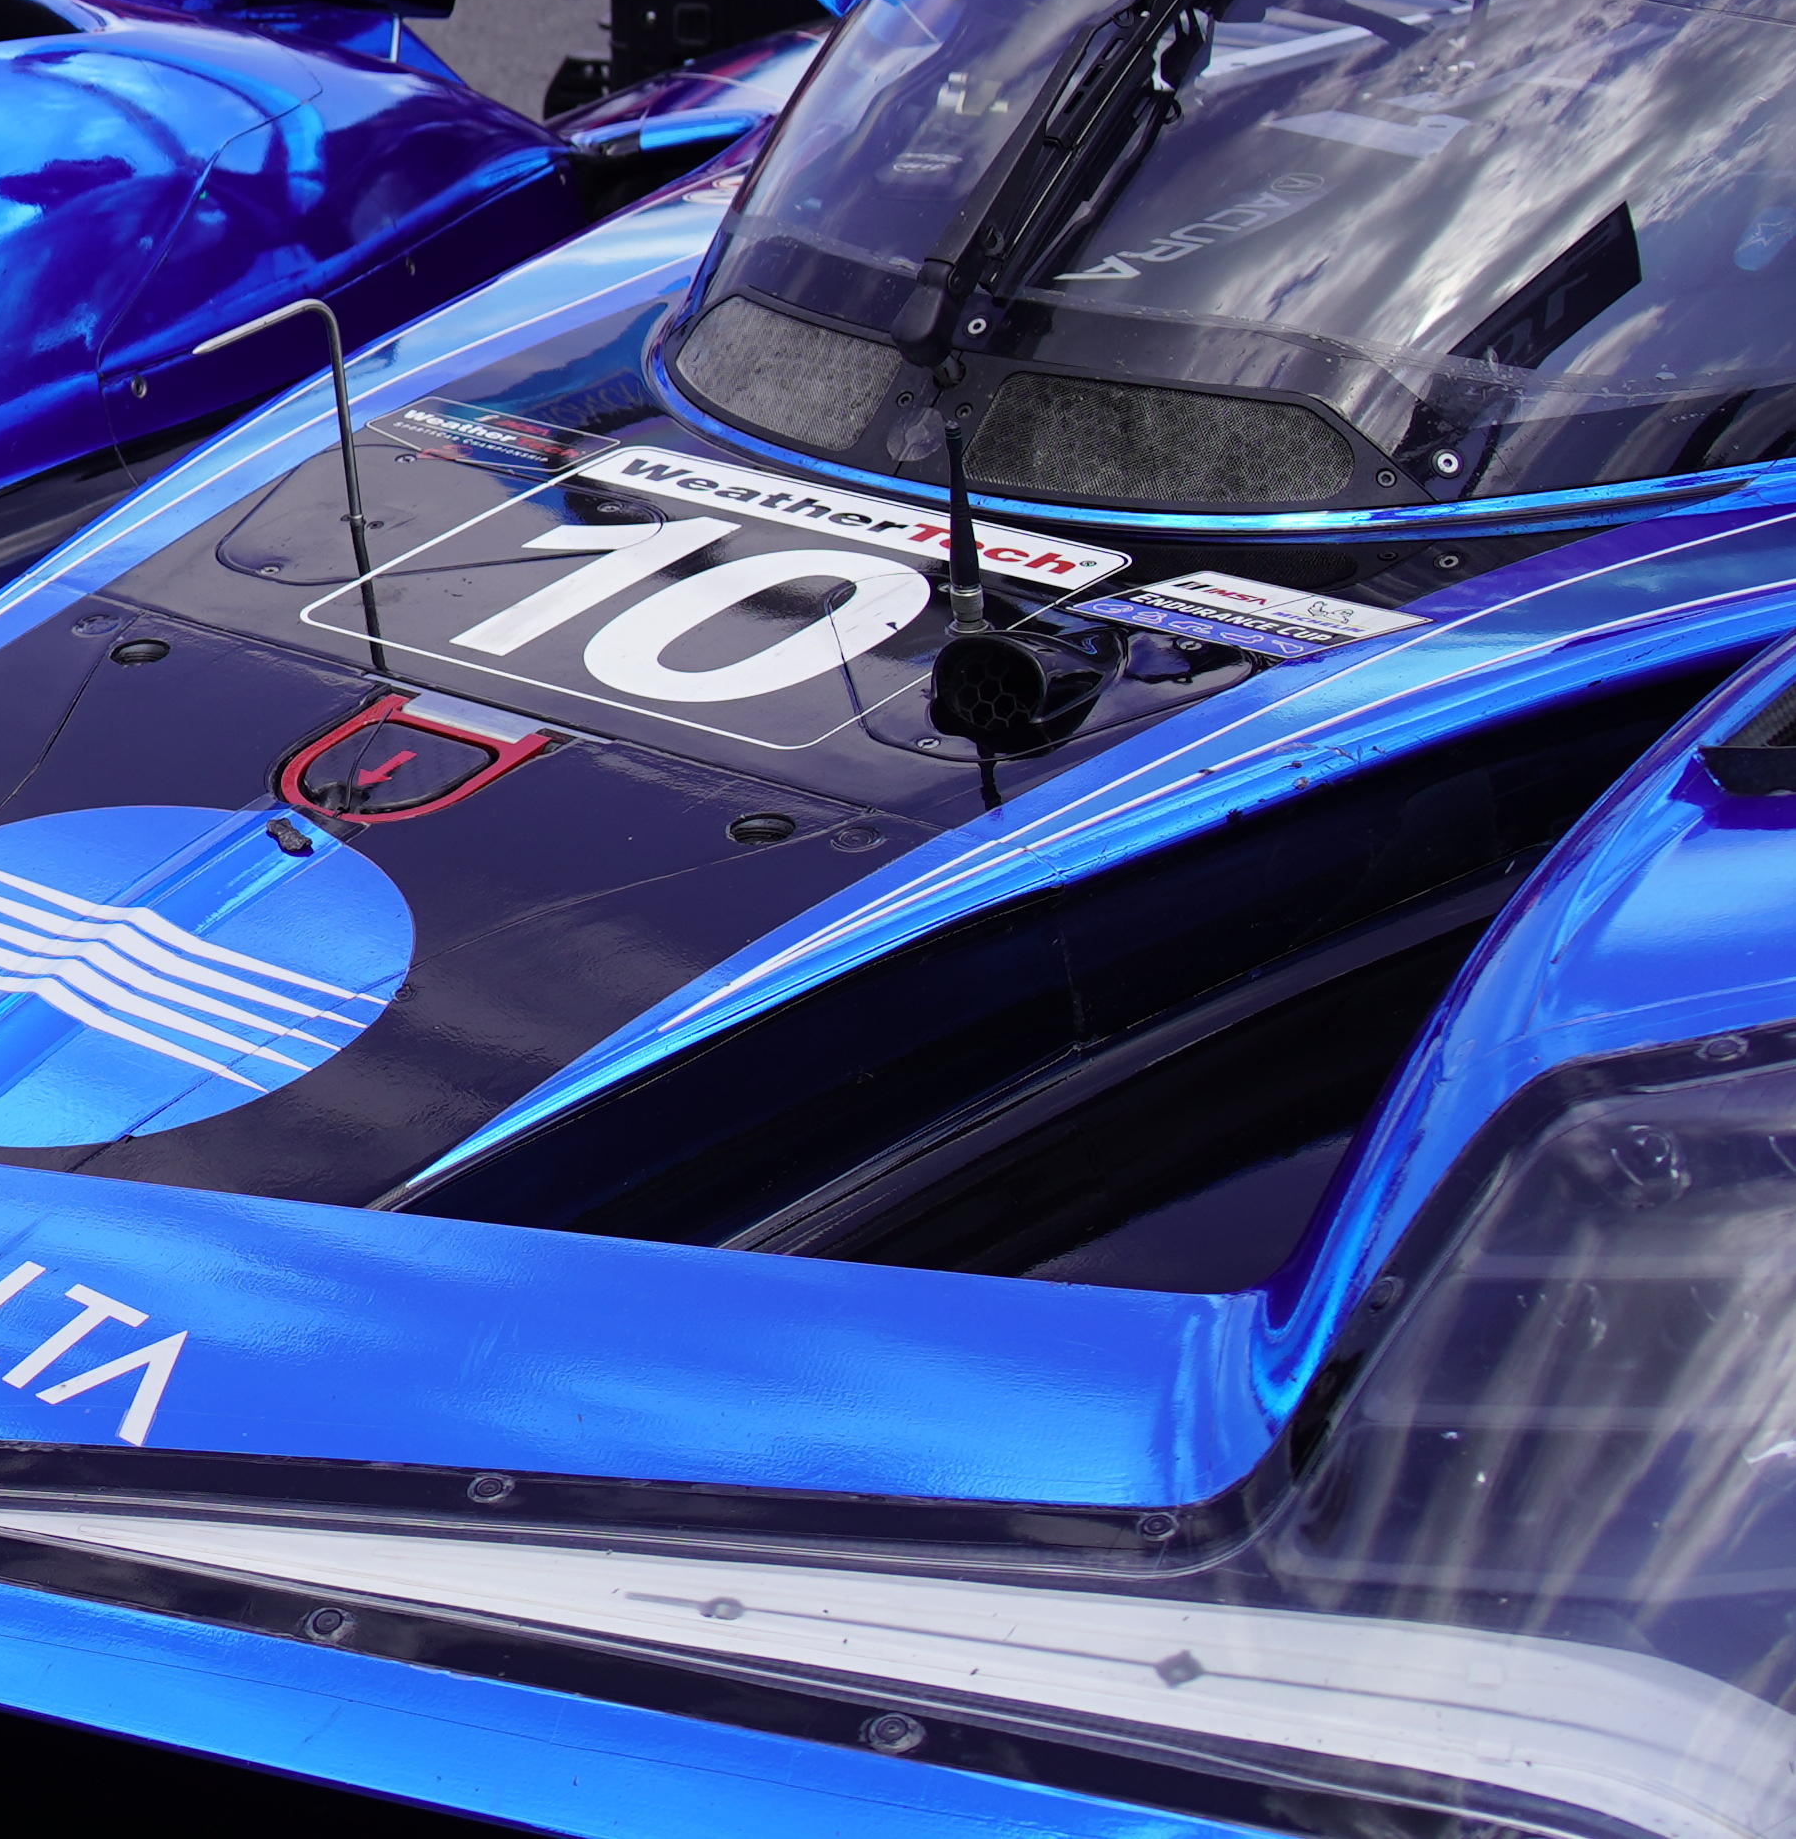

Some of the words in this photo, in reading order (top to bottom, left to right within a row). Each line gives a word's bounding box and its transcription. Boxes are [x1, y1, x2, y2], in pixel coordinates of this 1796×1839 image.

[1053, 191, 1292, 281] ACURA
[403, 409, 581, 459] WeatherTech
[449, 516, 931, 703] 10
[1129, 592, 1278, 632] ENDURANCE
[1272, 610, 1367, 634] MICHELIN
